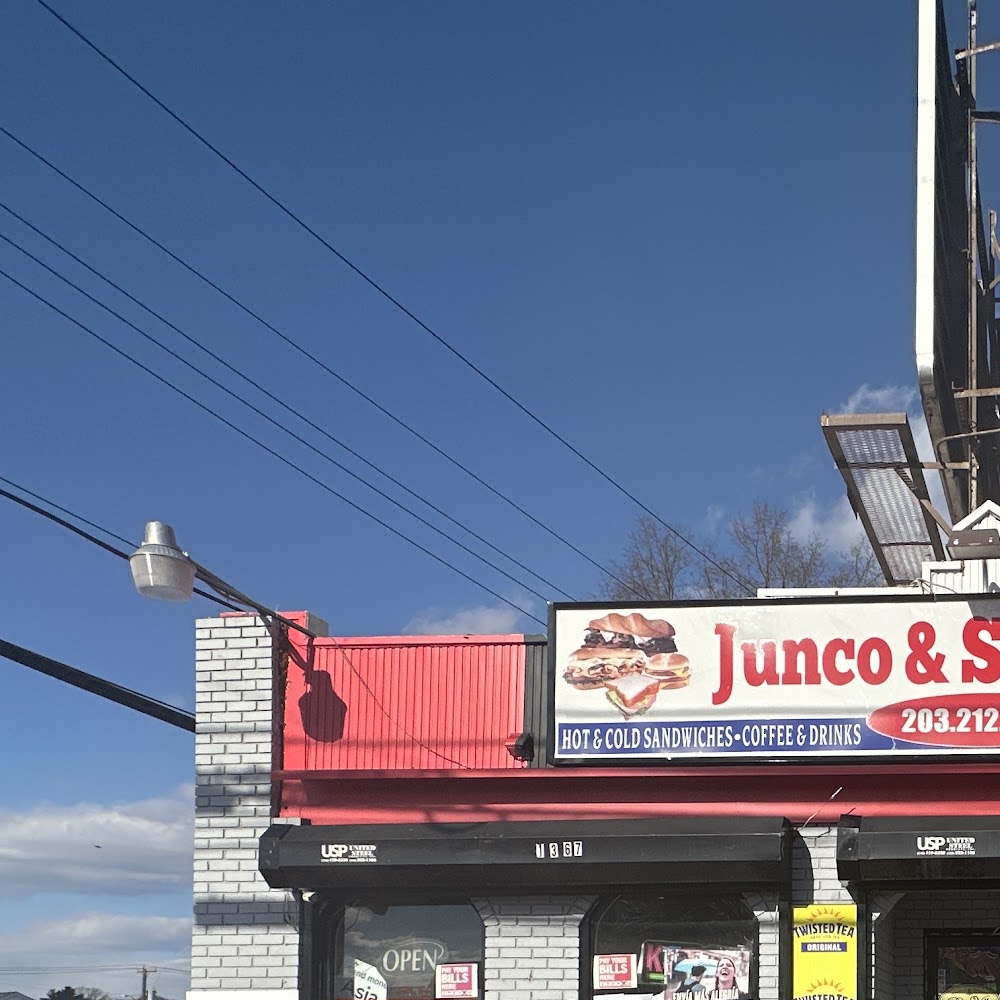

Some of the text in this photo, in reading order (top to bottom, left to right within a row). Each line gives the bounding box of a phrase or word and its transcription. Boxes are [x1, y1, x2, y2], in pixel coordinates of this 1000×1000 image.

[712, 622, 892, 705] Junco
[904, 621, 949, 684] &
[561, 727, 593, 750] HOT
[593, 731, 603, 749] &
[604, 727, 641, 750] COLD
[796, 728, 807, 745] &
[809, 723, 861, 747] DRINKS
[917, 836, 945, 850] USP
[321, 844, 348, 858] USP
[793, 922, 855, 938] TWISTED TEA
[806, 943, 842, 952] ORIGINAL
[383, 949, 438, 972] OPEN
[600, 964, 628, 974] BILLS
[441, 973, 469, 983] BILLS
[710, 986, 739, 1000] ALEGRÍA
